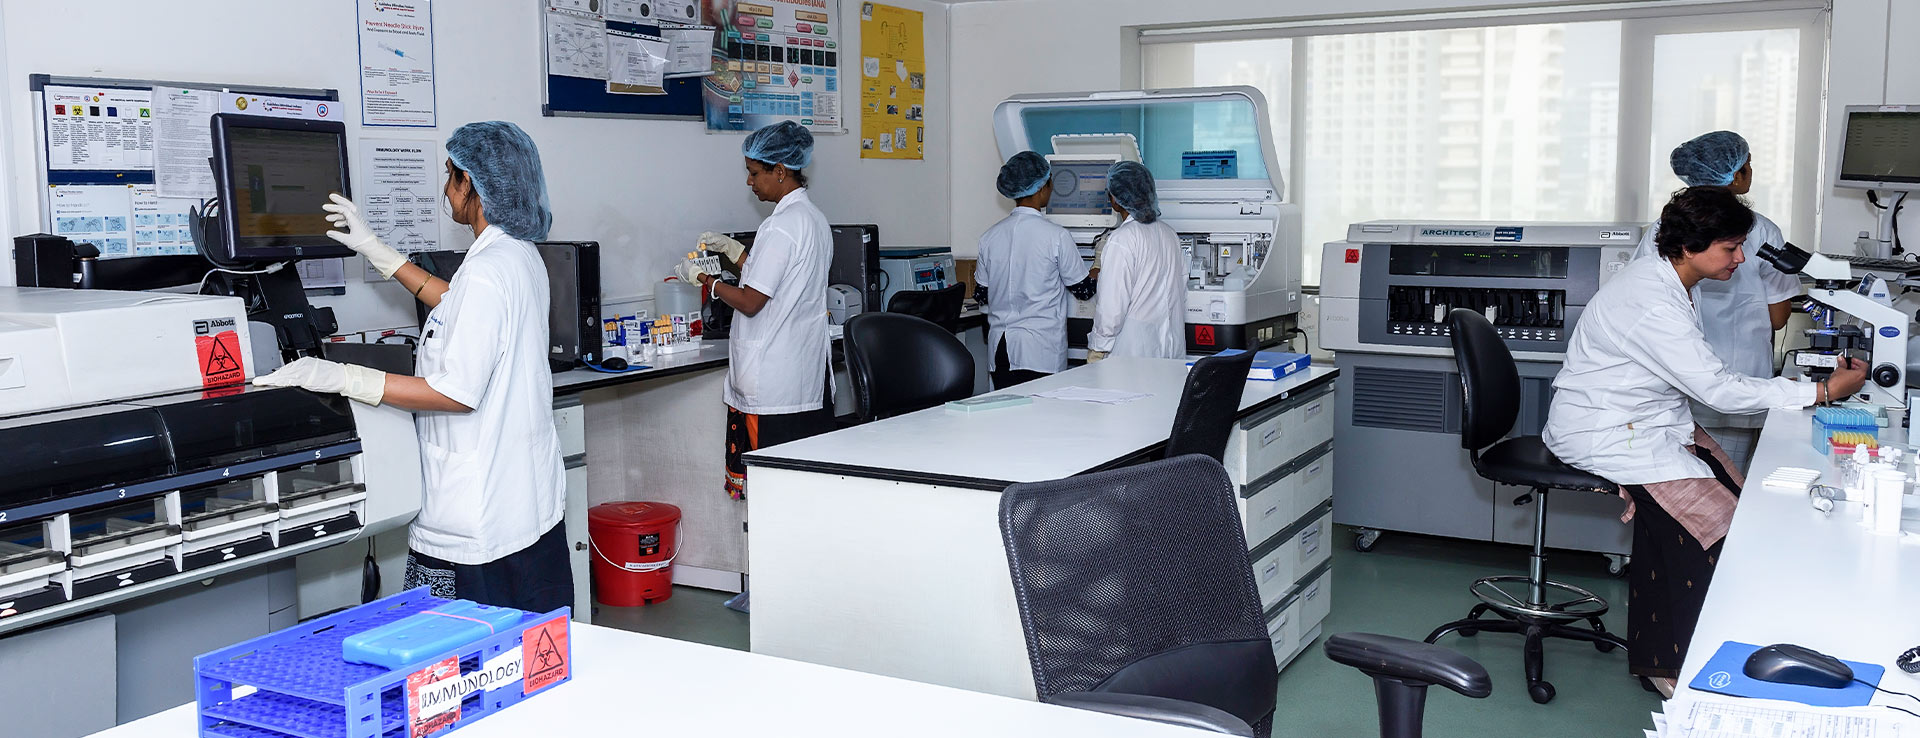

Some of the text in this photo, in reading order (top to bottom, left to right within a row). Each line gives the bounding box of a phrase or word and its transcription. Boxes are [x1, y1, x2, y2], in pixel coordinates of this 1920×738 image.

[210, 319, 235, 328] Abbott
[207, 371, 240, 383] BIOHAZARD
[315, 451, 321, 459] 5
[222, 468, 229, 477] 4
[118, 489, 125, 498] 3
[0, 512, 6, 522] 2
[529, 668, 564, 688] BIOHAZARD
[421, 658, 521, 709] IMMUNOLOGY
